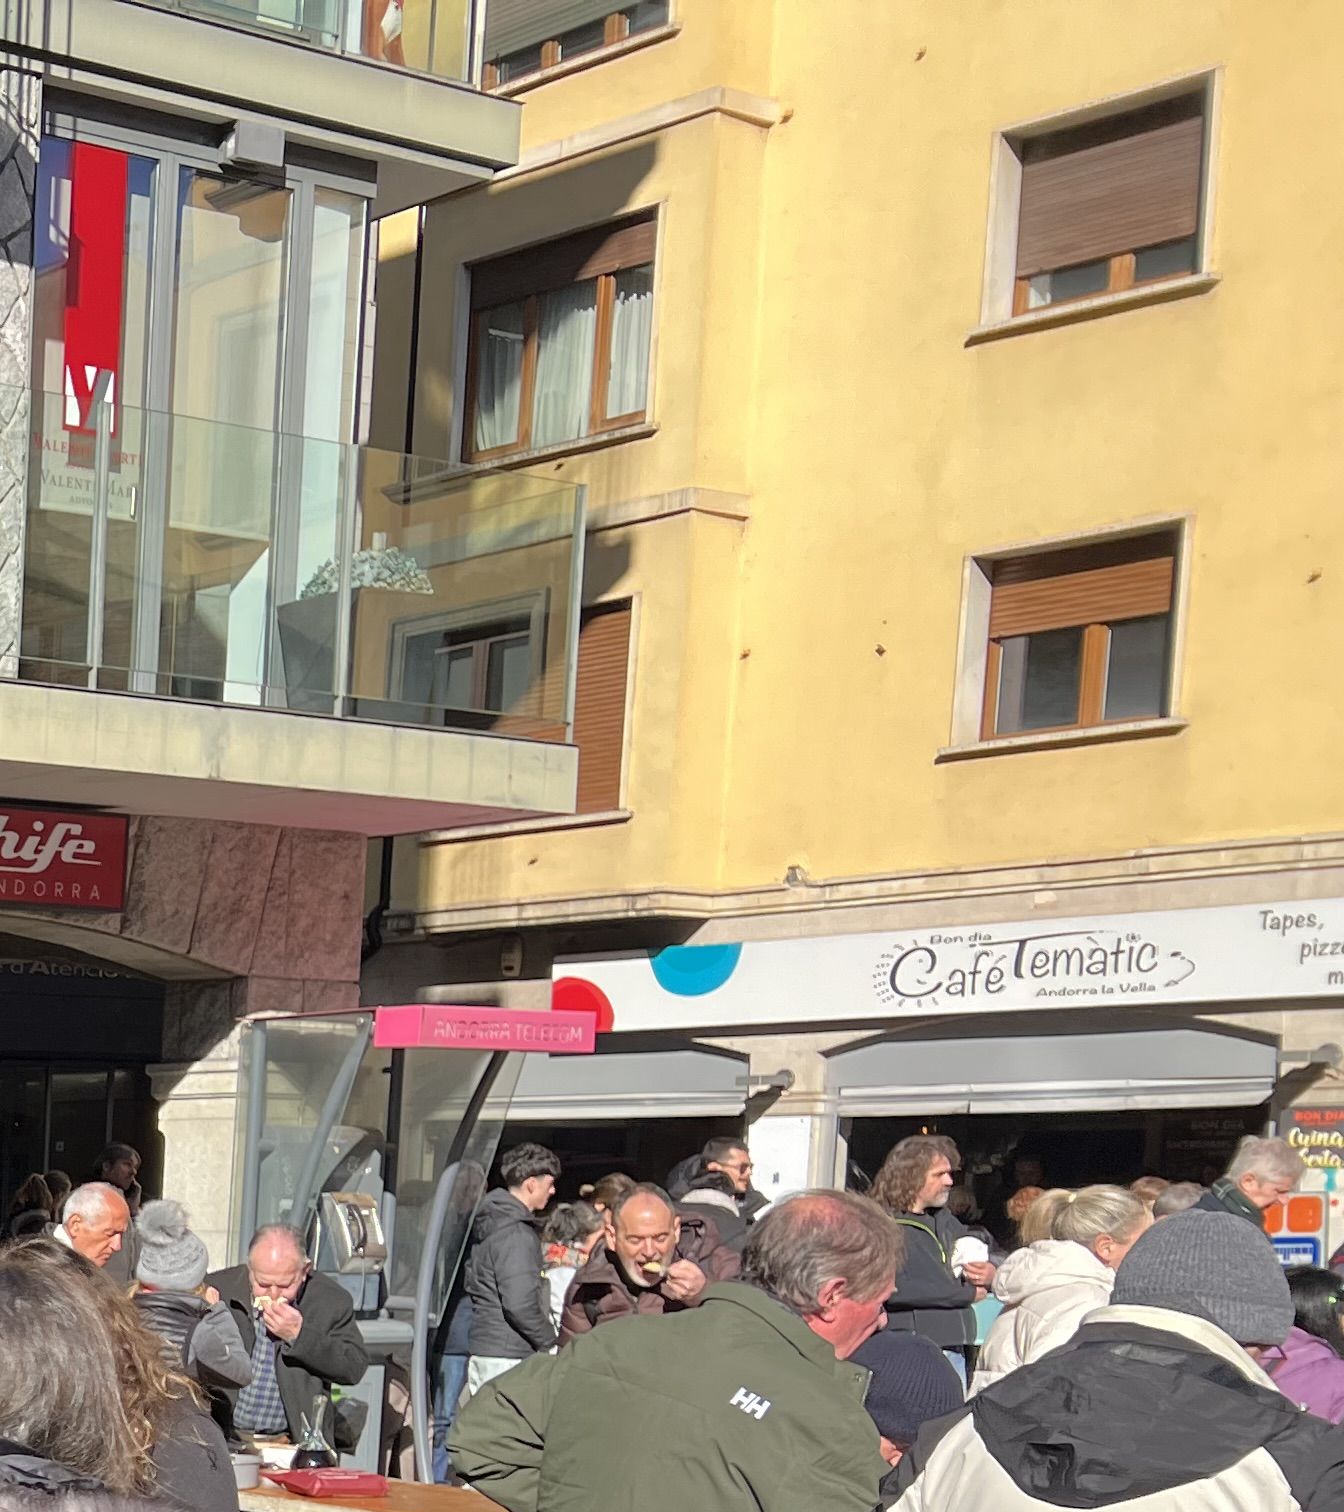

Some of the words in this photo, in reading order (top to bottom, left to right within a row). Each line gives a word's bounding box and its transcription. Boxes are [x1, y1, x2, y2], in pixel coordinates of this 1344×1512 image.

[40, 468, 94, 492] VALENT
[1259, 909, 1325, 937] Tapes,
[930, 934, 965, 944] Bon
[968, 931, 992, 942] dia
[889, 947, 1006, 999] Café
[978, 930, 1160, 979] Temàtic
[1036, 985, 1098, 998] Andorra
[1101, 984, 1114, 996] la
[1120, 981, 1157, 994] Vella
[433, 1020, 511, 1041] ANDORRA
[516, 1023, 583, 1043] TELECOM
[730, 1387, 771, 1420] HH
